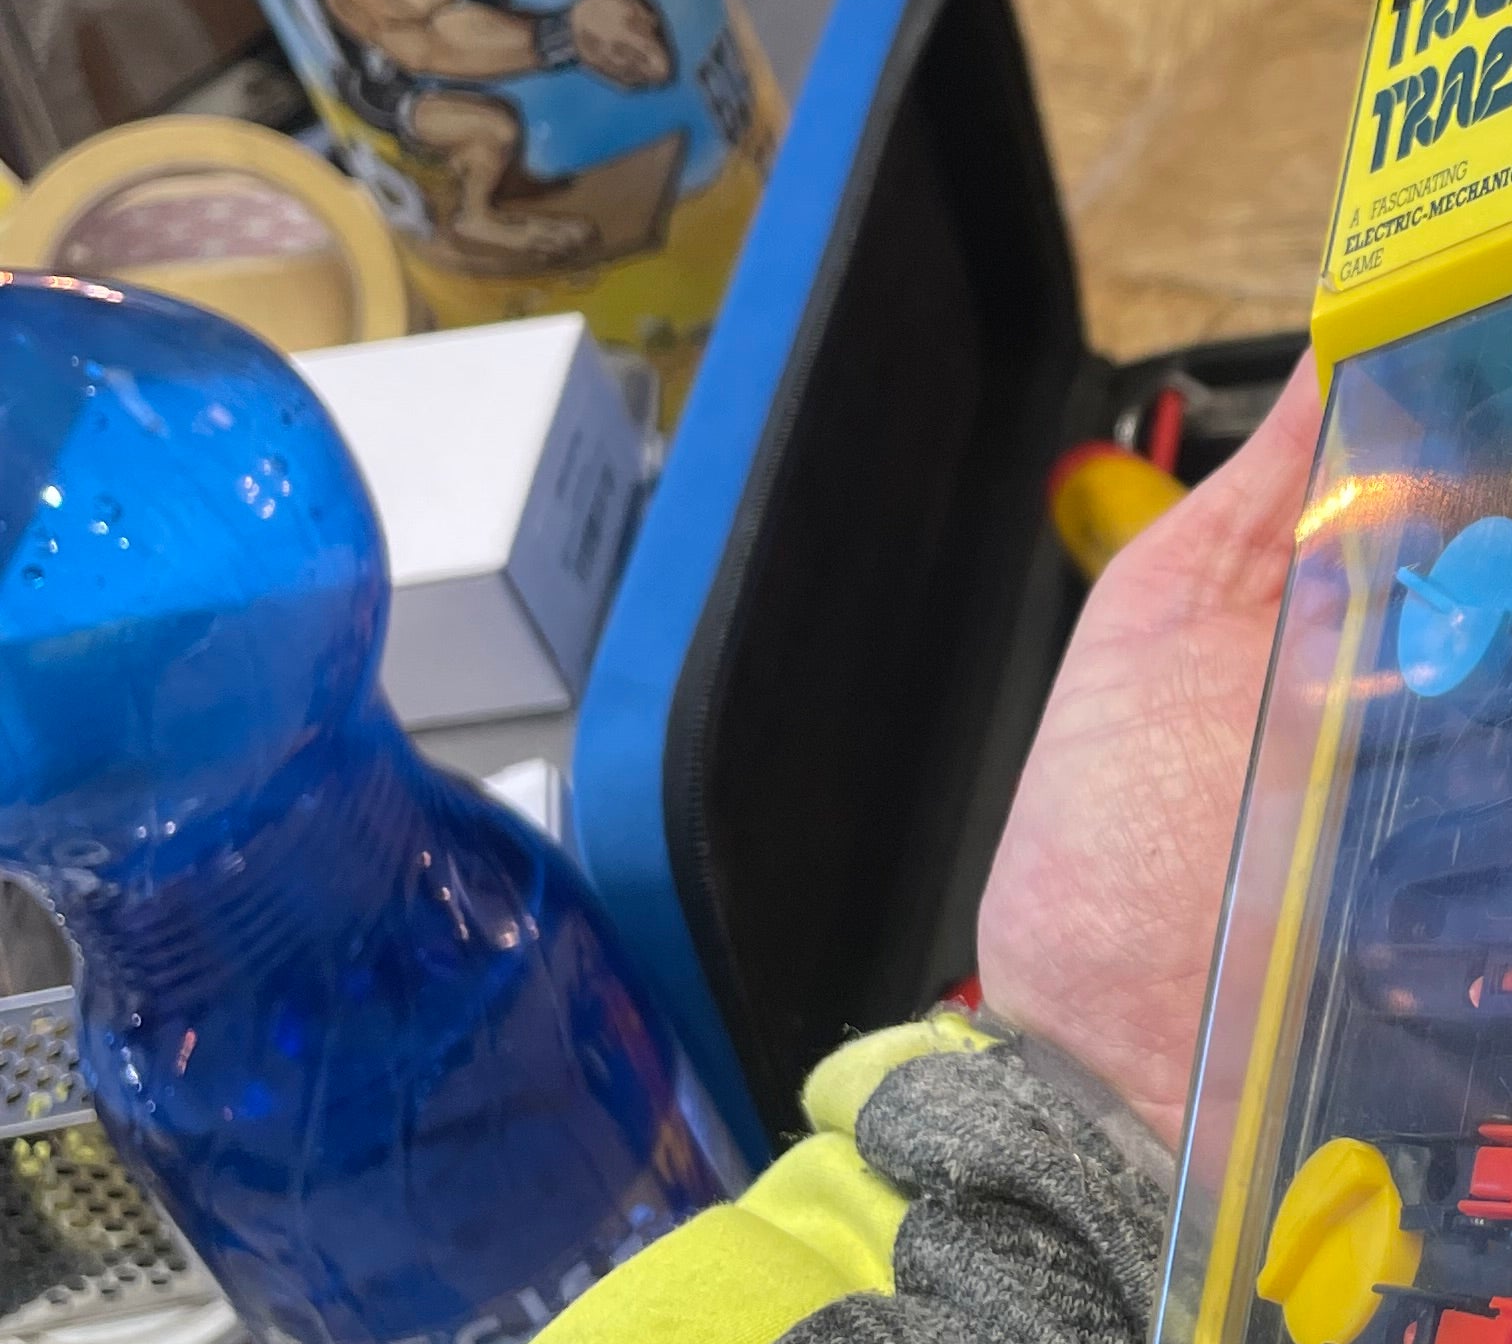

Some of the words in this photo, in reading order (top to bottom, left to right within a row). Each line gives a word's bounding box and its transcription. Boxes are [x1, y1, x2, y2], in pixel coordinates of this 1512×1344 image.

[1349, 206, 1360, 229] A
[1369, 159, 1469, 221] FASCINATING
[1339, 247, 1385, 283] GAME
